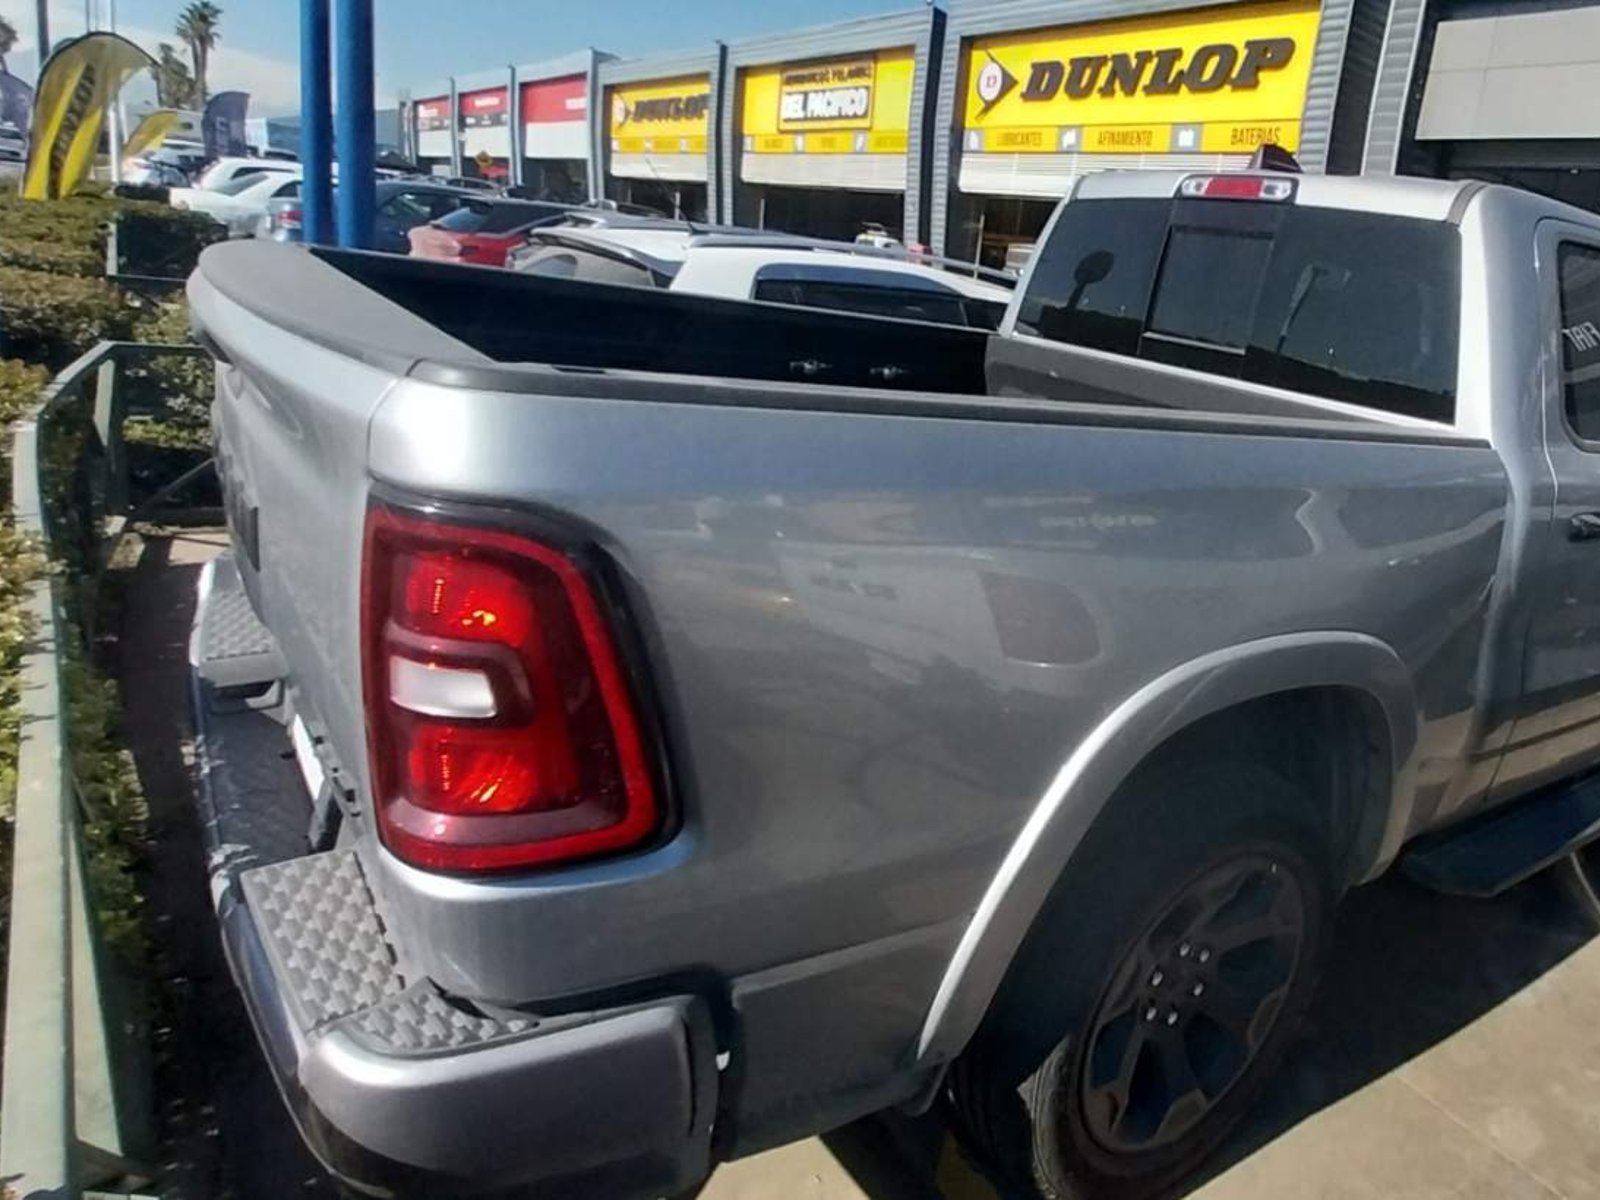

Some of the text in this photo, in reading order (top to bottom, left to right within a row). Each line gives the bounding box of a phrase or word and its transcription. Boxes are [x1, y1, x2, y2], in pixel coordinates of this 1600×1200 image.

[1020, 37, 1296, 102] DUNLOP
[1097, 130, 1153, 146] AFINAMIENTO
[1230, 126, 1281, 146] BATERIAS
